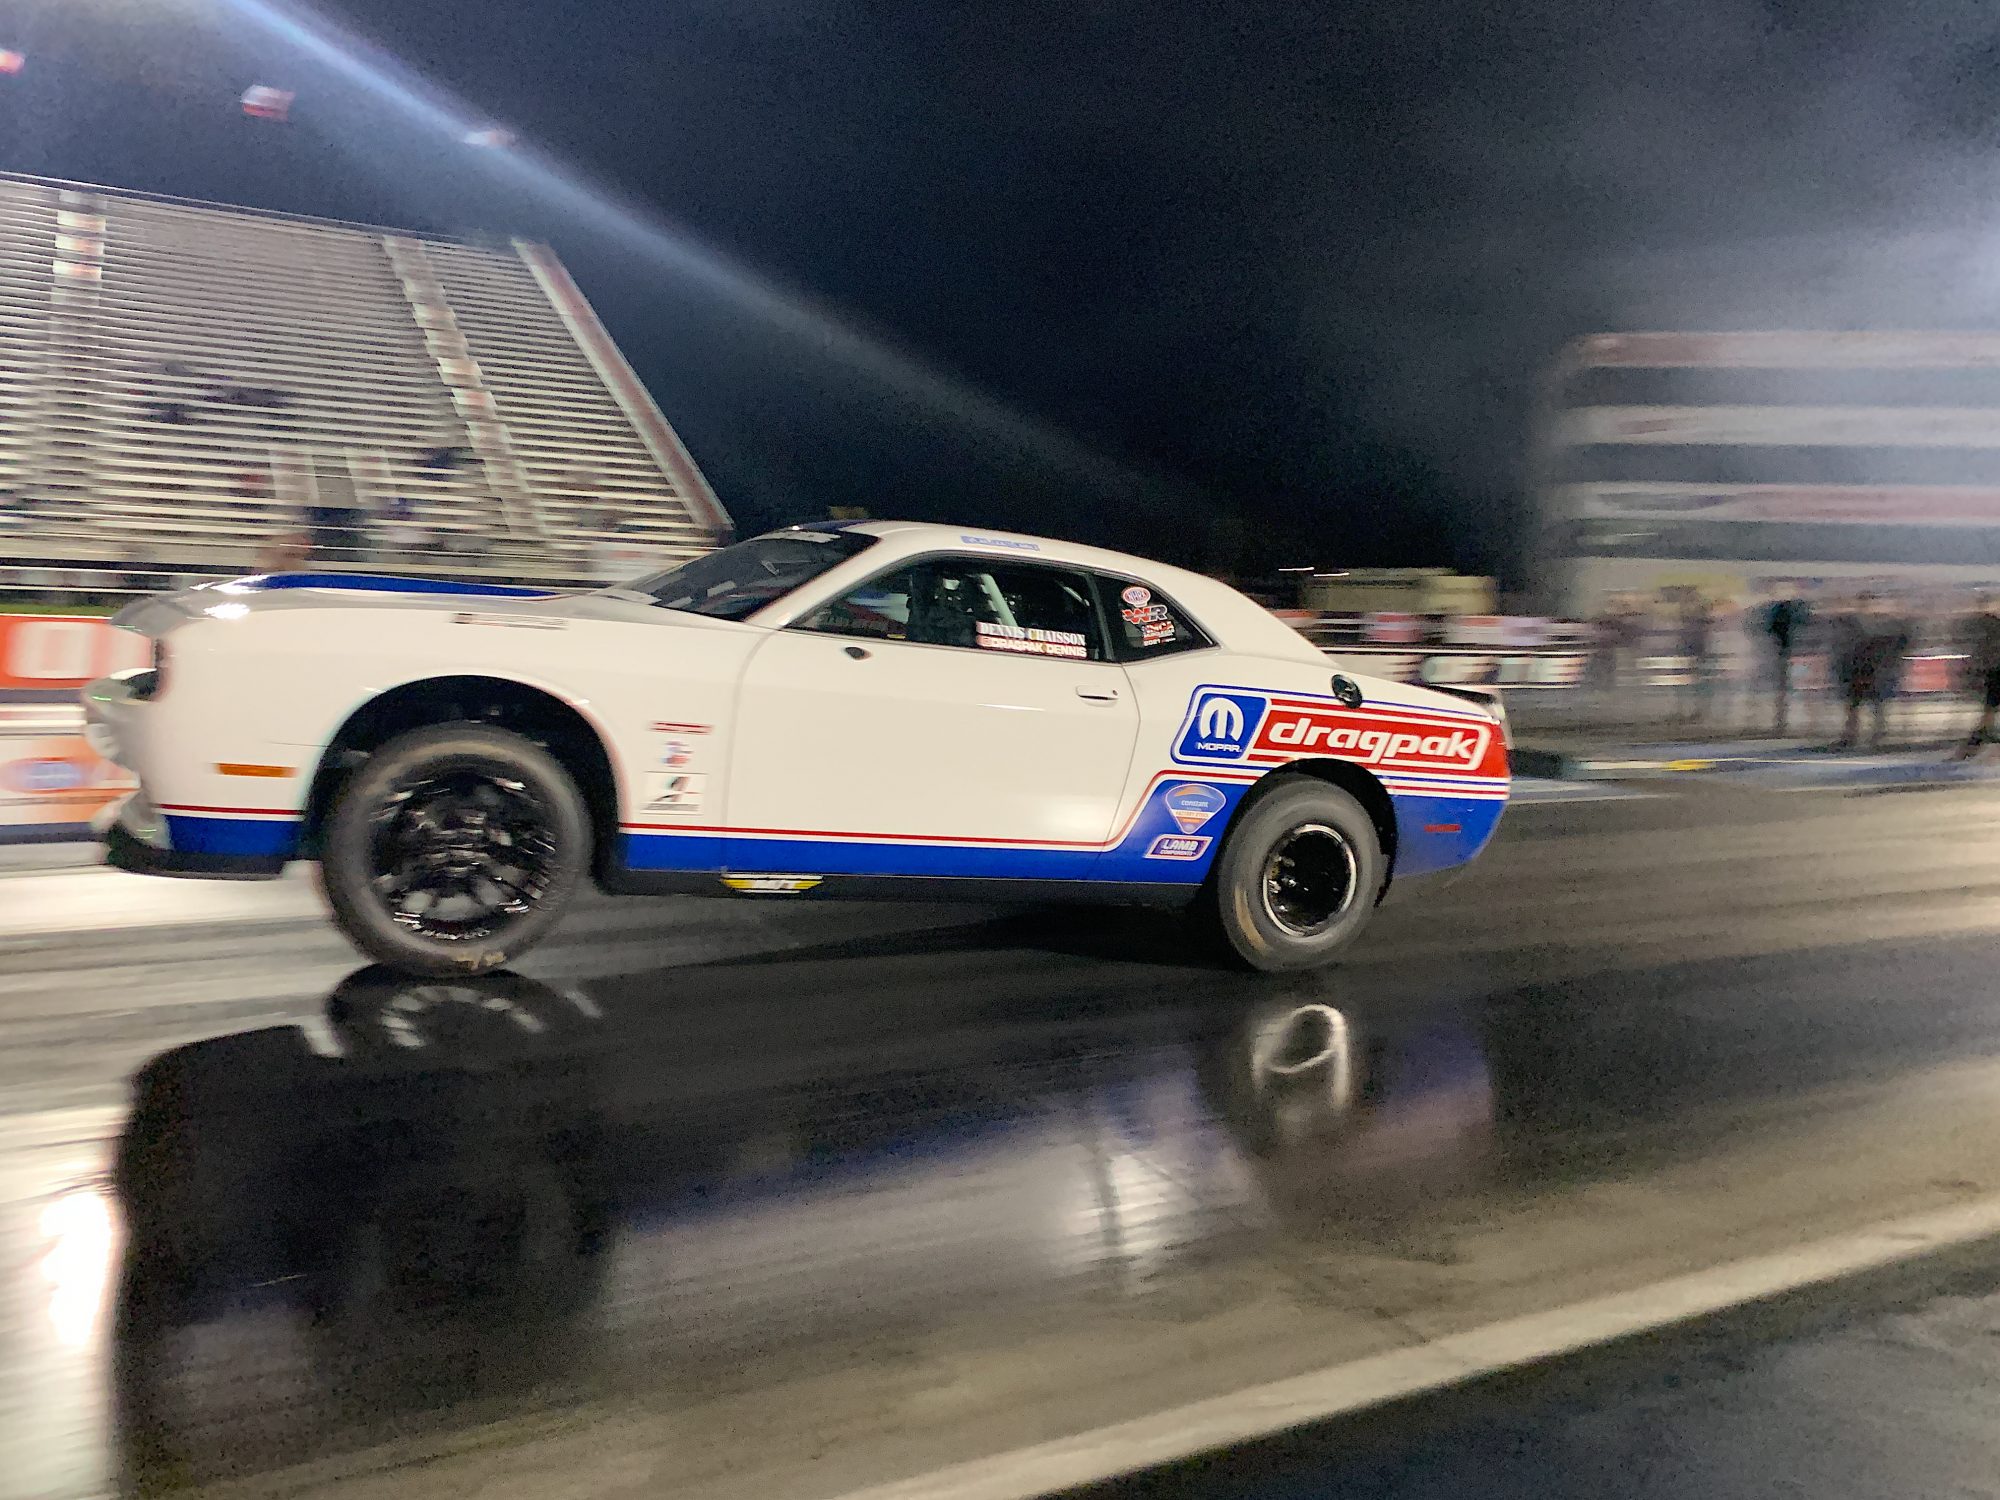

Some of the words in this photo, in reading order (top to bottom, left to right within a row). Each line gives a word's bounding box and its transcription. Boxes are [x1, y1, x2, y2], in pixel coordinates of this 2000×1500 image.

[1268, 717, 1478, 764] dragpak
[1197, 742, 1240, 752] MOPAR
[1162, 840, 1199, 851] LAMB
